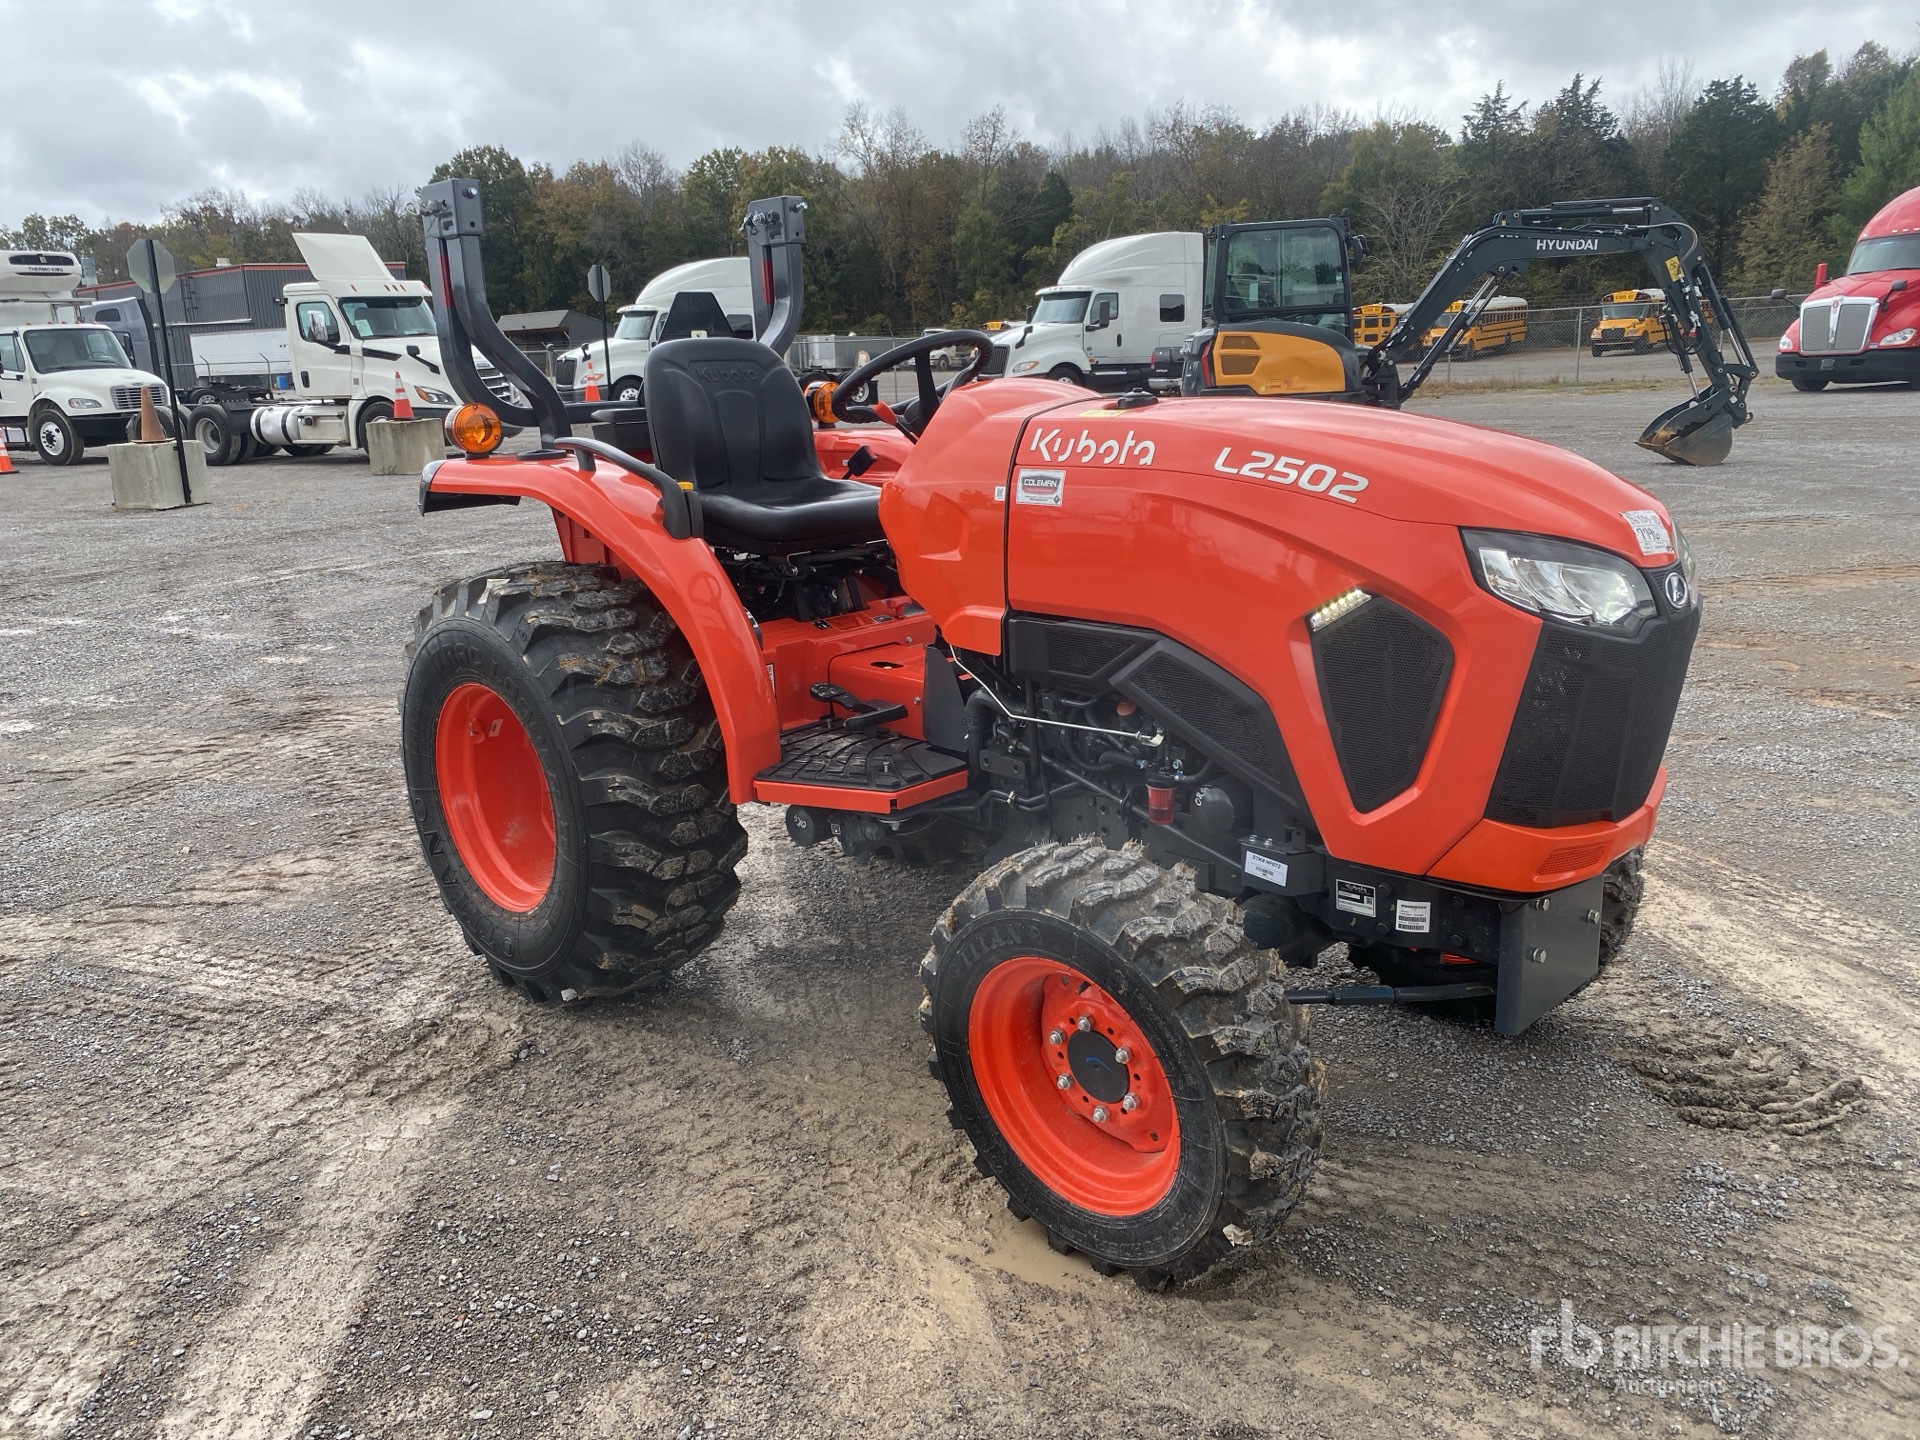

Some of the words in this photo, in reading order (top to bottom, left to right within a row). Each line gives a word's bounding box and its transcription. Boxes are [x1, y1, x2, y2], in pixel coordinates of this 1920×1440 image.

[1536, 239, 1599, 251] HYUNDAI
[695, 366, 760, 384] Kubota
[1030, 428, 1156, 466] Kubota
[1023, 478, 1058, 488] COLEMAN
[1213, 446, 1370, 504] L2502
[956, 923, 1022, 970] TITAN
